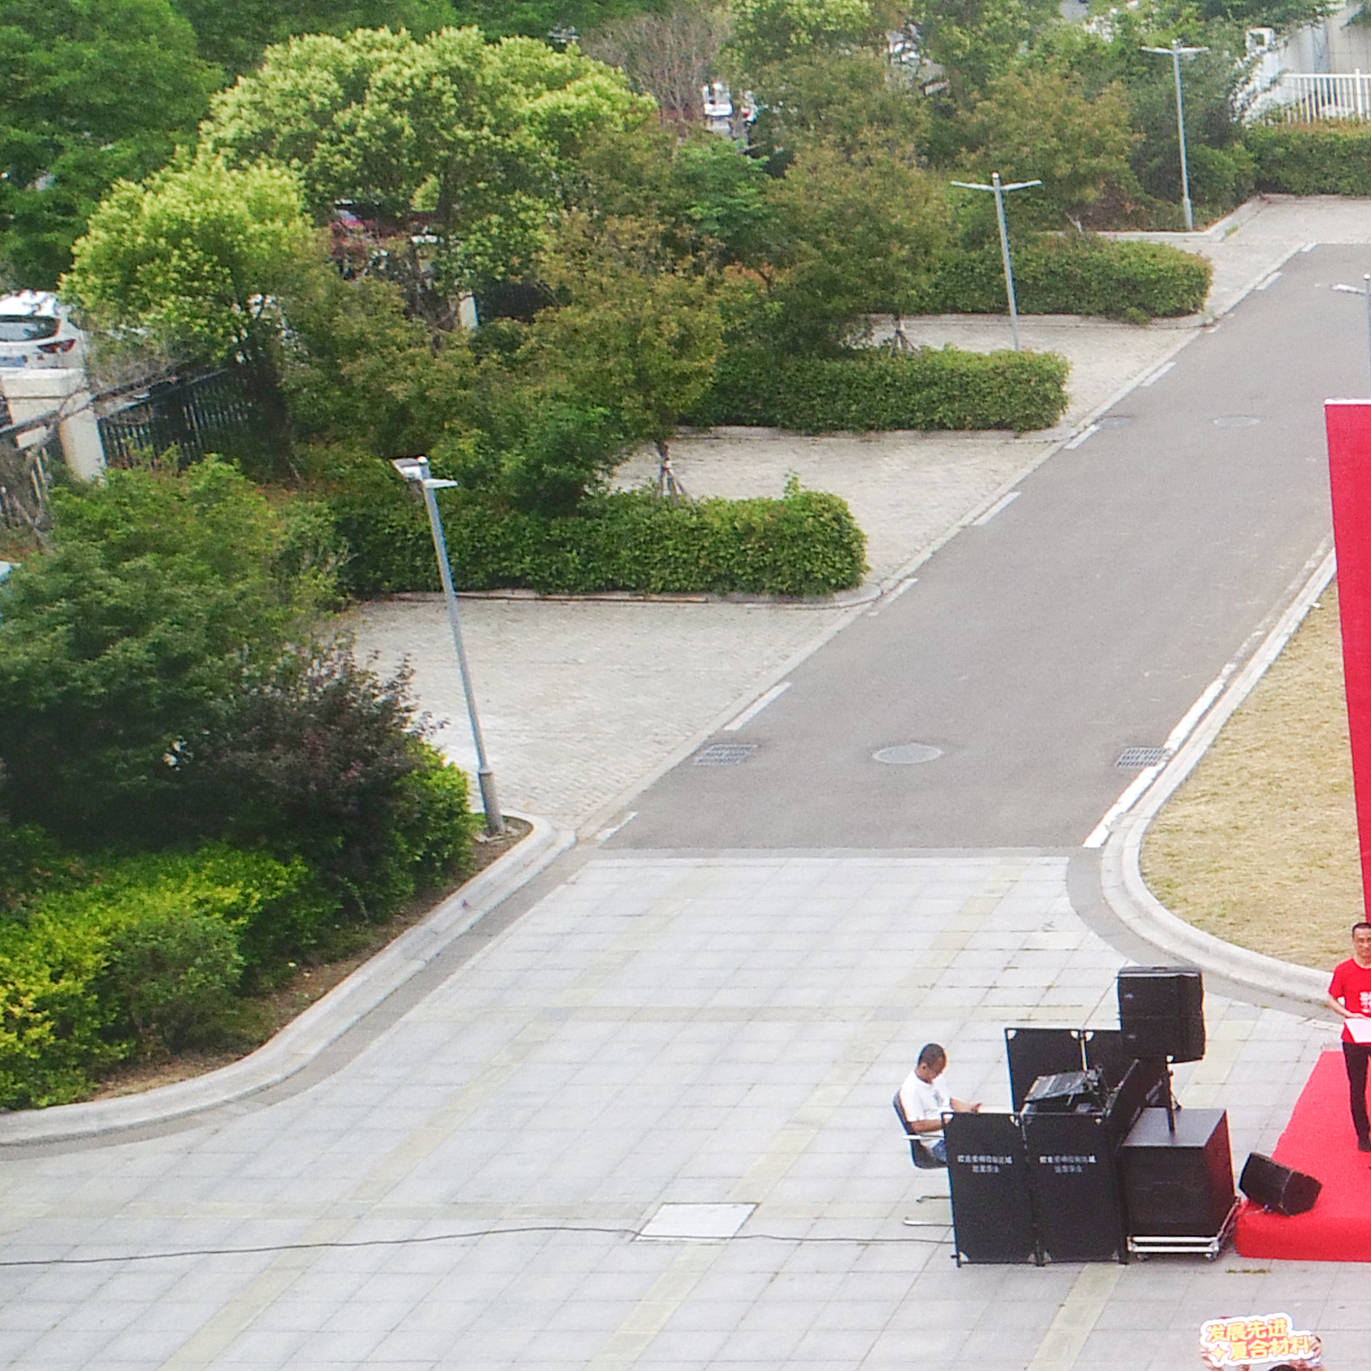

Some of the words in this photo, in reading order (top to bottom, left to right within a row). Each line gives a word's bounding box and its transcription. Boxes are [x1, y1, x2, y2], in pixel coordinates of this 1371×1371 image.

[1206, 1317, 1289, 1343] 发展先进
[1228, 1335, 1310, 1362] 复合材料
